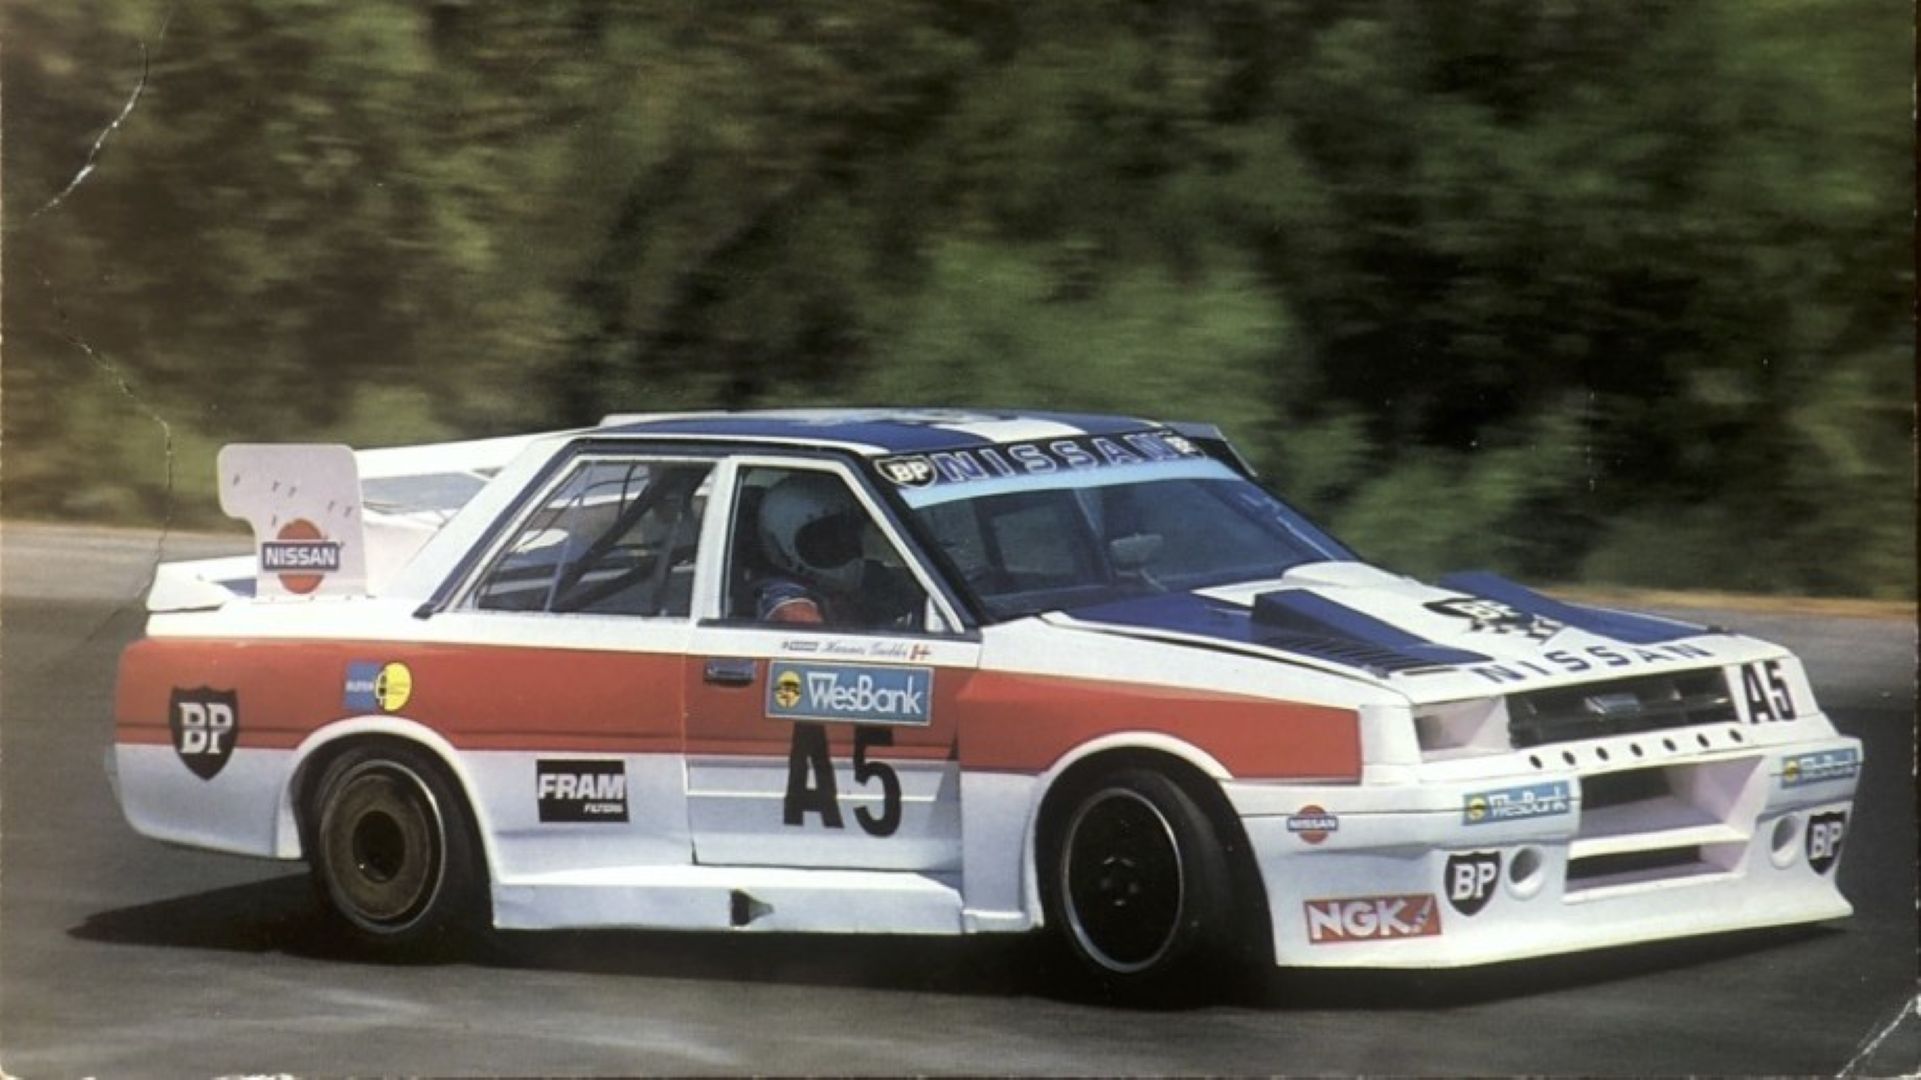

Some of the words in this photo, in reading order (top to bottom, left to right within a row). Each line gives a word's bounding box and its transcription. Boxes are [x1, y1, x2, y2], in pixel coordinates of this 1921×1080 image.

[889, 461, 930, 482] BP
[936, 431, 1179, 483] NISSAN
[264, 546, 337, 567] NISSAN
[1471, 643, 1715, 684] NISSAN
[806, 671, 923, 714] WesBank
[1740, 659, 1797, 724] A5
[178, 702, 233, 754] BP
[538, 773, 625, 800] FRAM
[783, 721, 902, 838] A5
[1807, 821, 1843, 860] BP
[1452, 862, 1497, 900] BP
[1307, 899, 1413, 940] NGK
